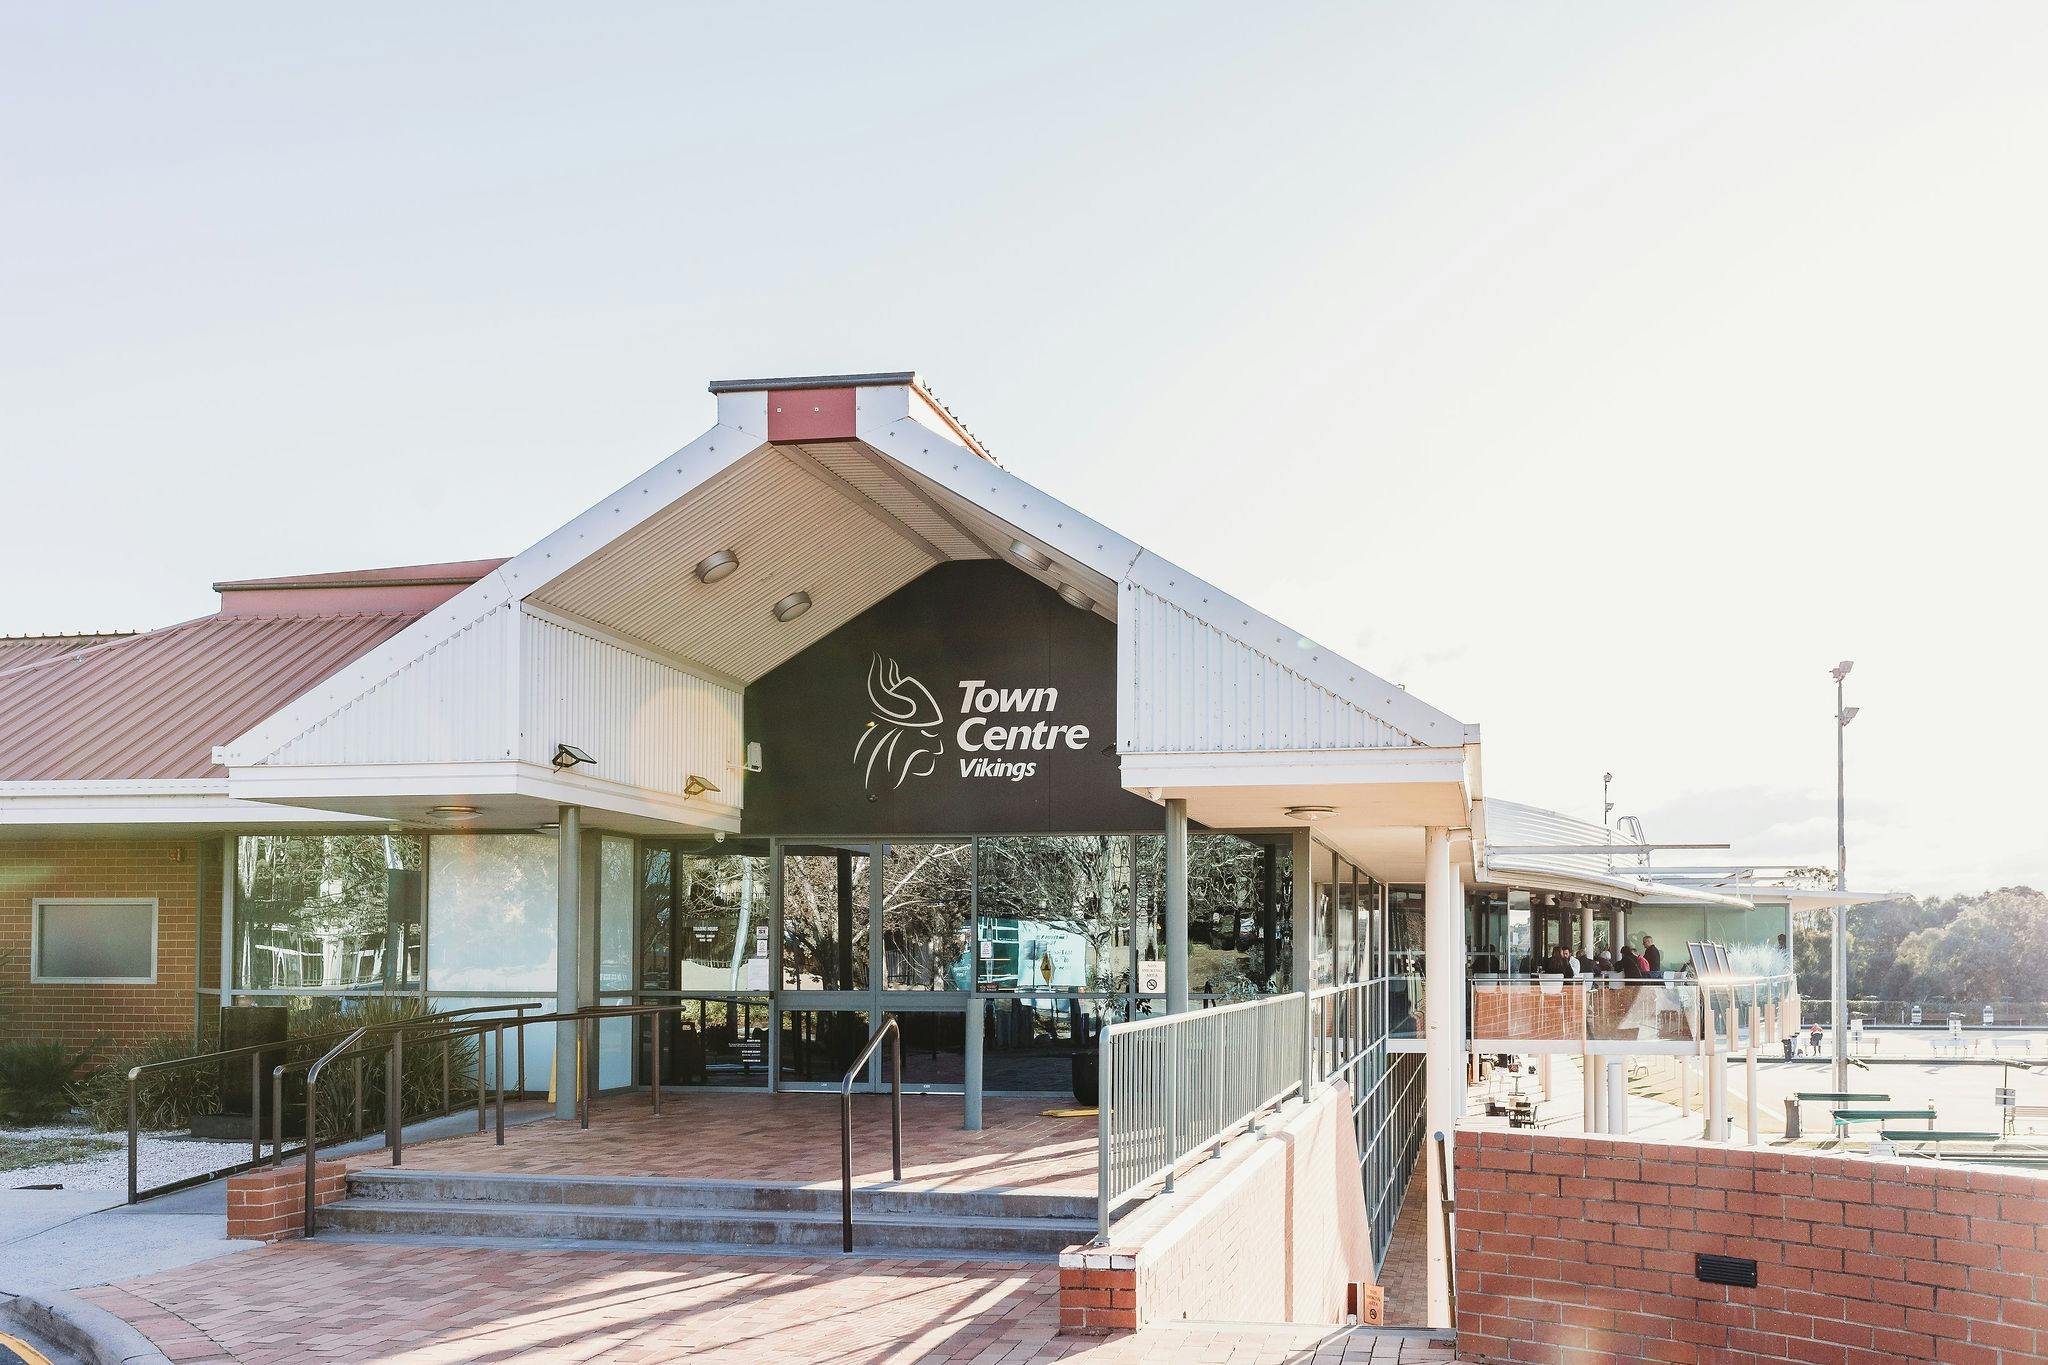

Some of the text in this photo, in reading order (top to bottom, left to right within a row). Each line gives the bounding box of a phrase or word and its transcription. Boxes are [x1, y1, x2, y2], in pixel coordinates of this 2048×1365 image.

[958, 680, 1058, 712] Town
[956, 717, 1090, 752] Centre
[959, 758, 1037, 782] Vikings
